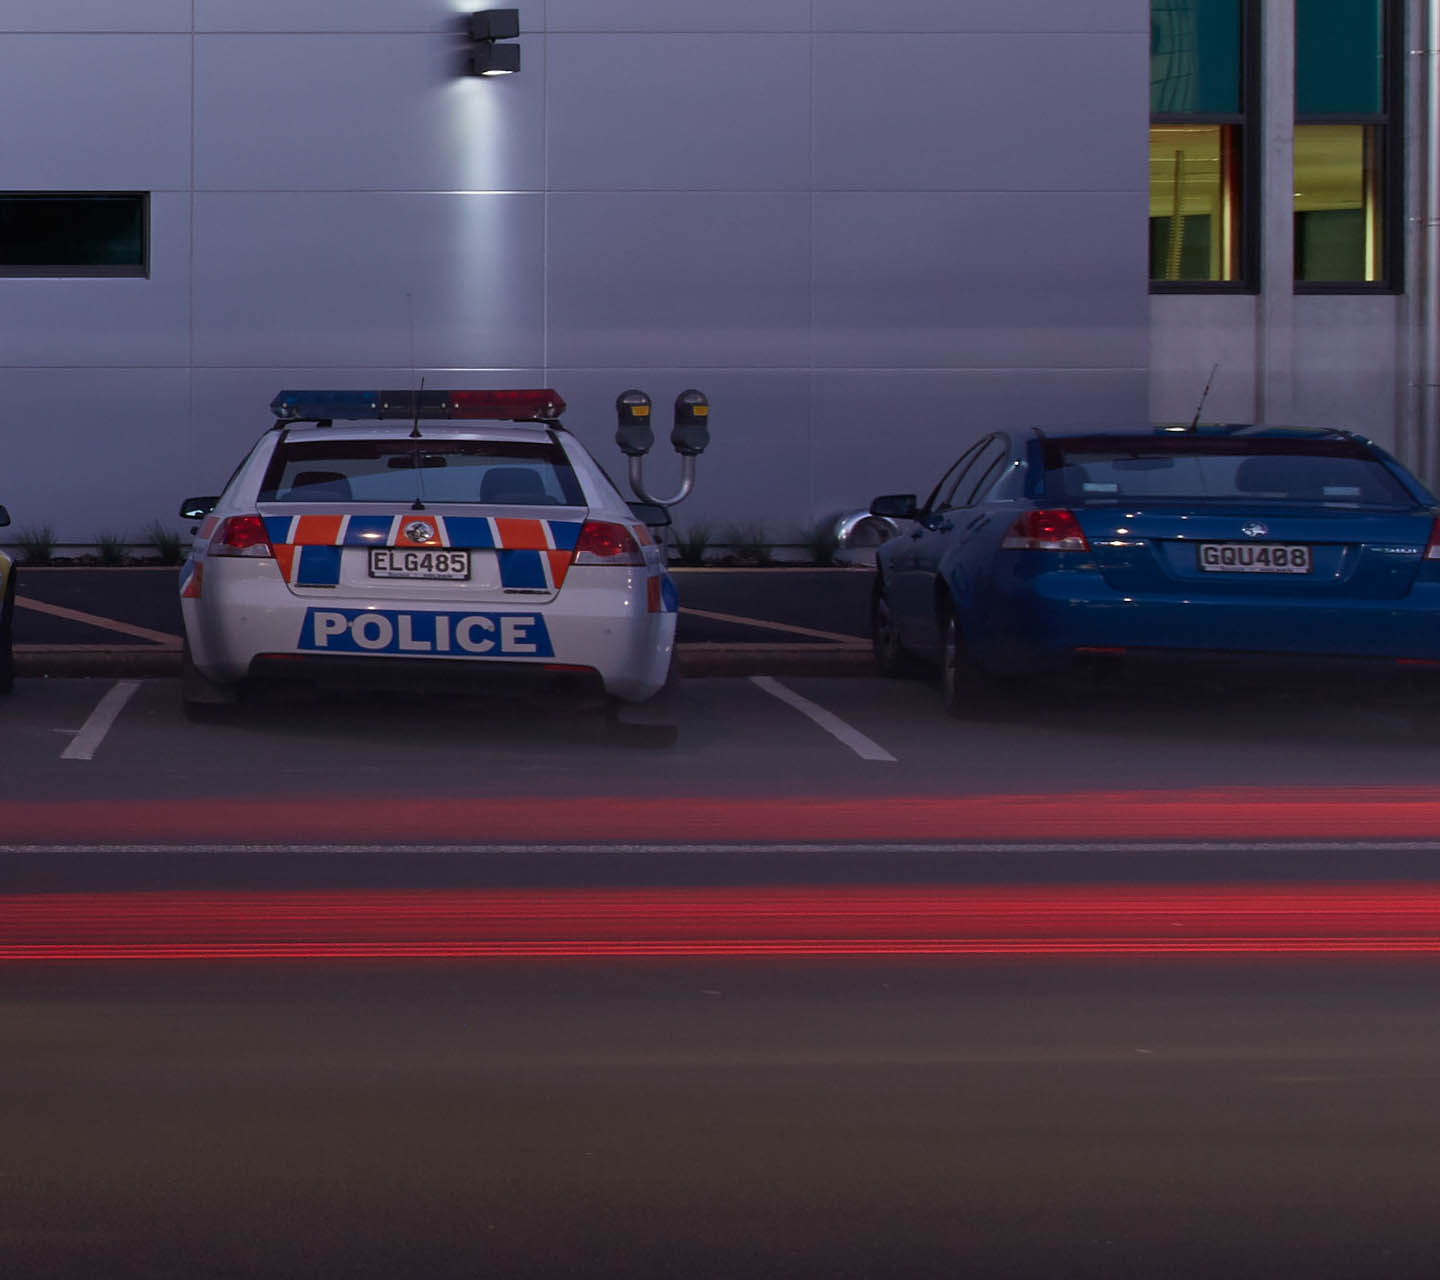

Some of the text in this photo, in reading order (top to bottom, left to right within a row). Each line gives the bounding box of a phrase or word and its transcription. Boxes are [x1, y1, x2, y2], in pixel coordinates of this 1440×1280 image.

[374, 552, 465, 573] ELG485
[1204, 547, 1306, 567] GQU408
[313, 612, 537, 654] POLICE
